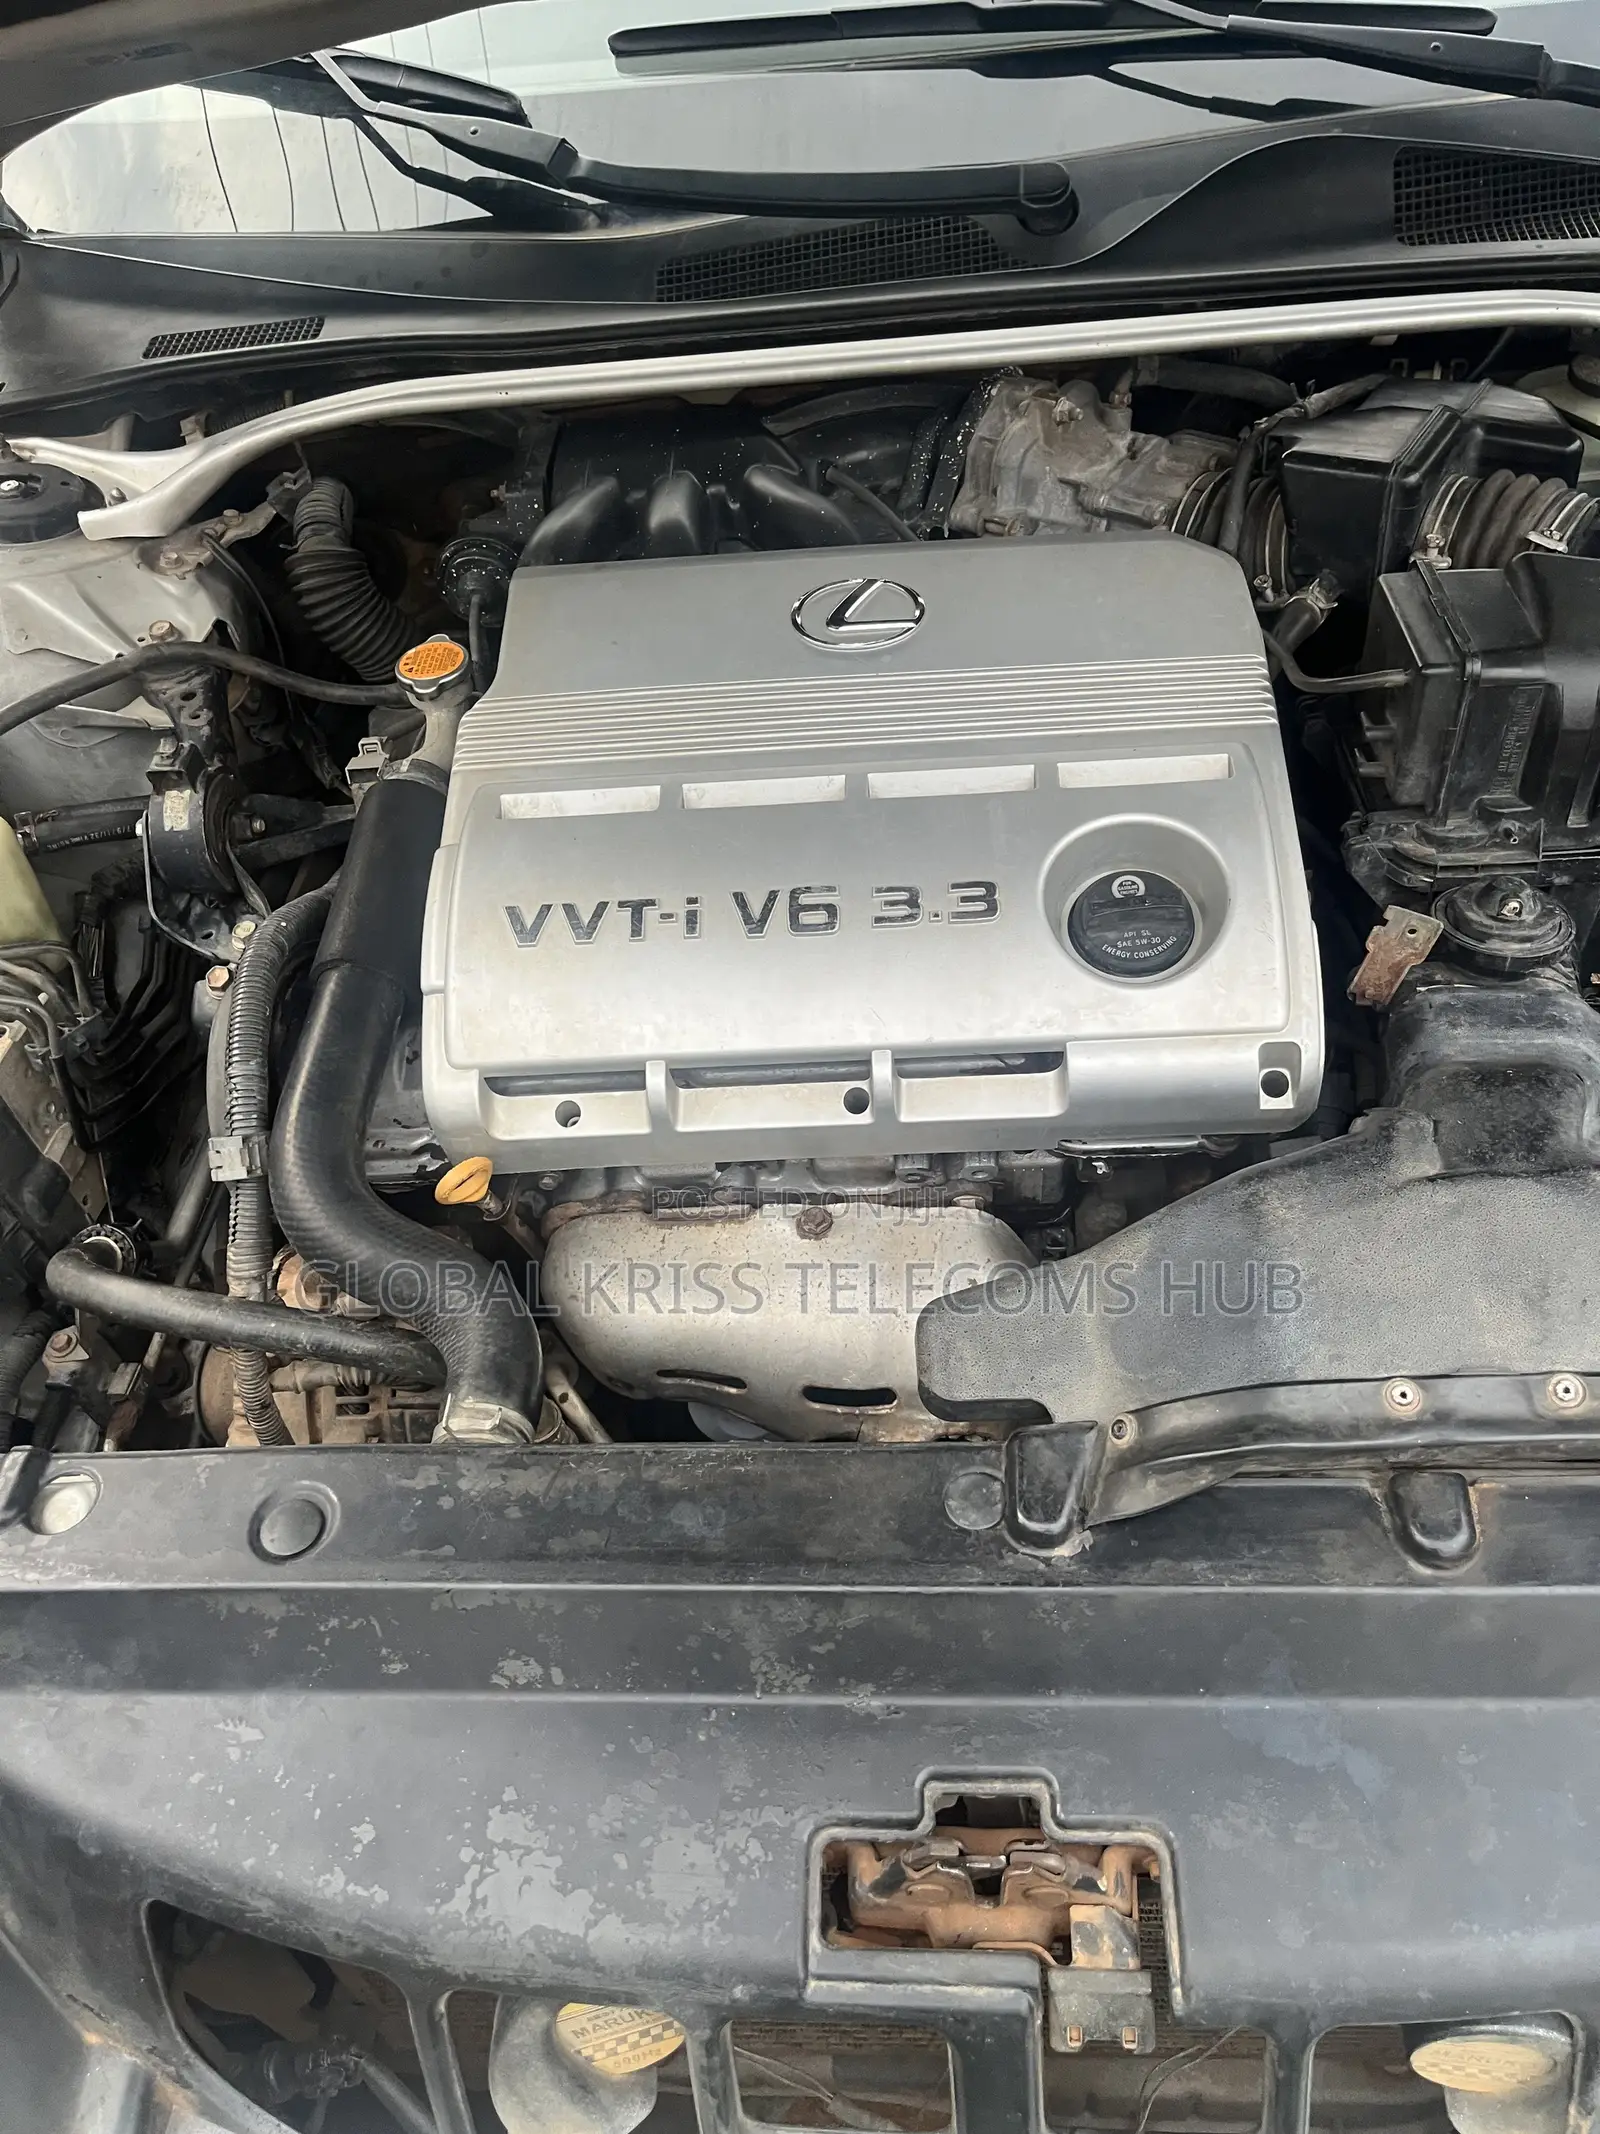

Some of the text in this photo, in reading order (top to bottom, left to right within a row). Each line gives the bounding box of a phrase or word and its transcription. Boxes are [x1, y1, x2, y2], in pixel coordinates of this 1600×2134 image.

[502, 880, 1000, 949] VVT-i V6 3.3
[1101, 935, 1177, 959] ENERGY CONSERVING
[1117, 937, 1161, 948] SAE 5W-30
[571, 2009, 652, 2039] MARUK
